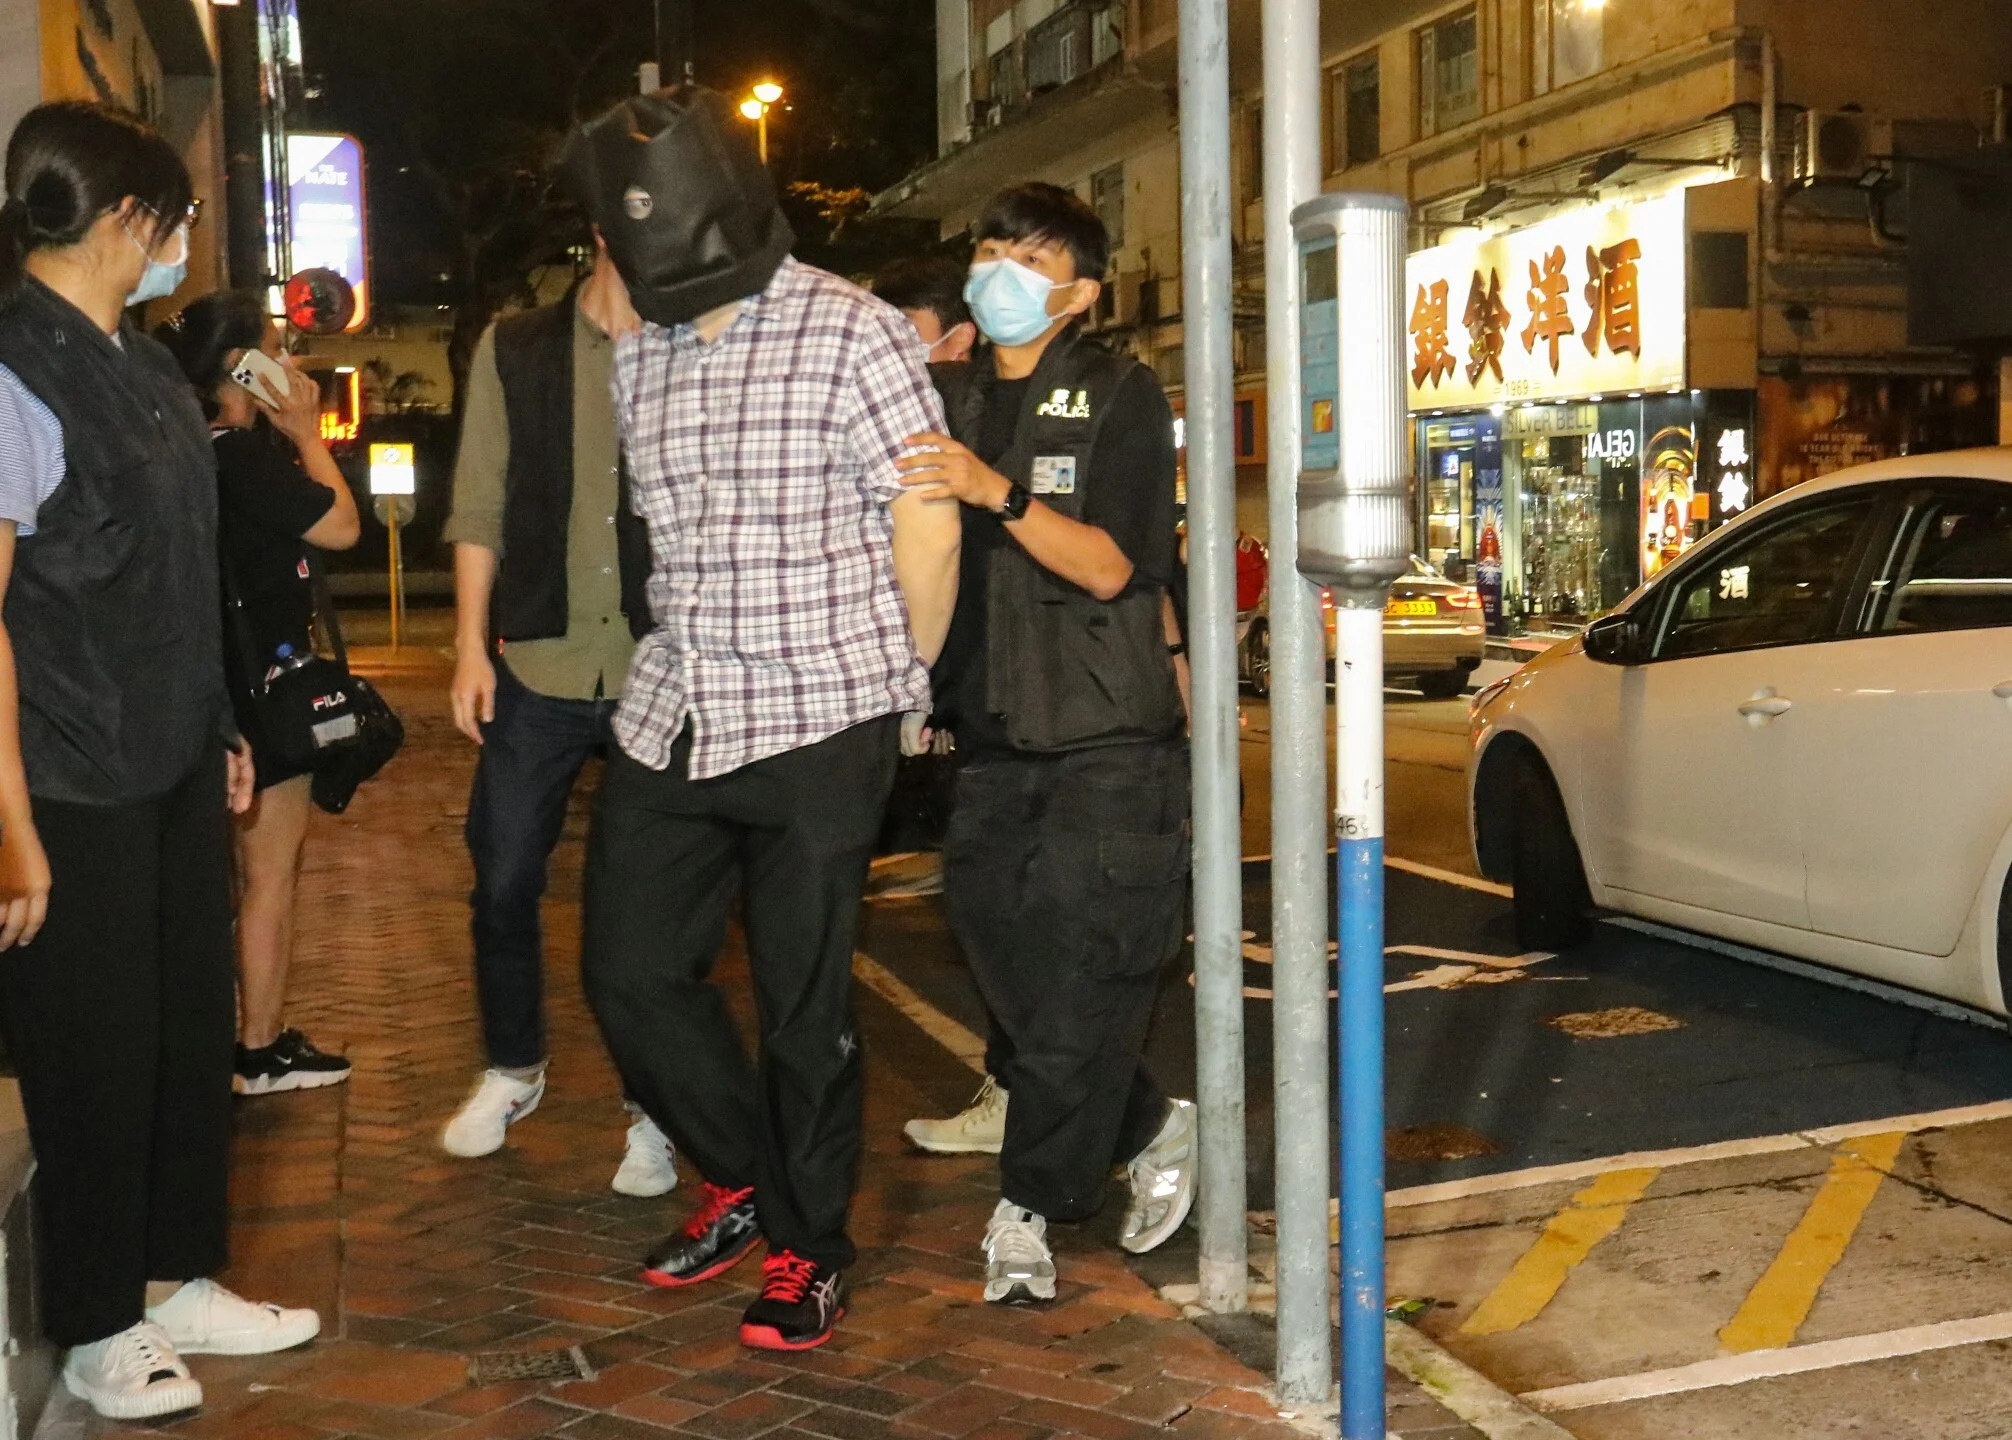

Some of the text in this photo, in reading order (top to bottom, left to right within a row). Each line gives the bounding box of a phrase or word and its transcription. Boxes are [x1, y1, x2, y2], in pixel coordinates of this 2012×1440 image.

[1409, 238, 1641, 390] 銀鈴洋酒
[1506, 380, 1528, 396] 1969
[1507, 404, 1592, 433] SILVER BELL
[1717, 428, 1750, 599] 銀鈴酒
[1404, 603, 1433, 613] 3333
[312, 691, 347, 711] FILA
